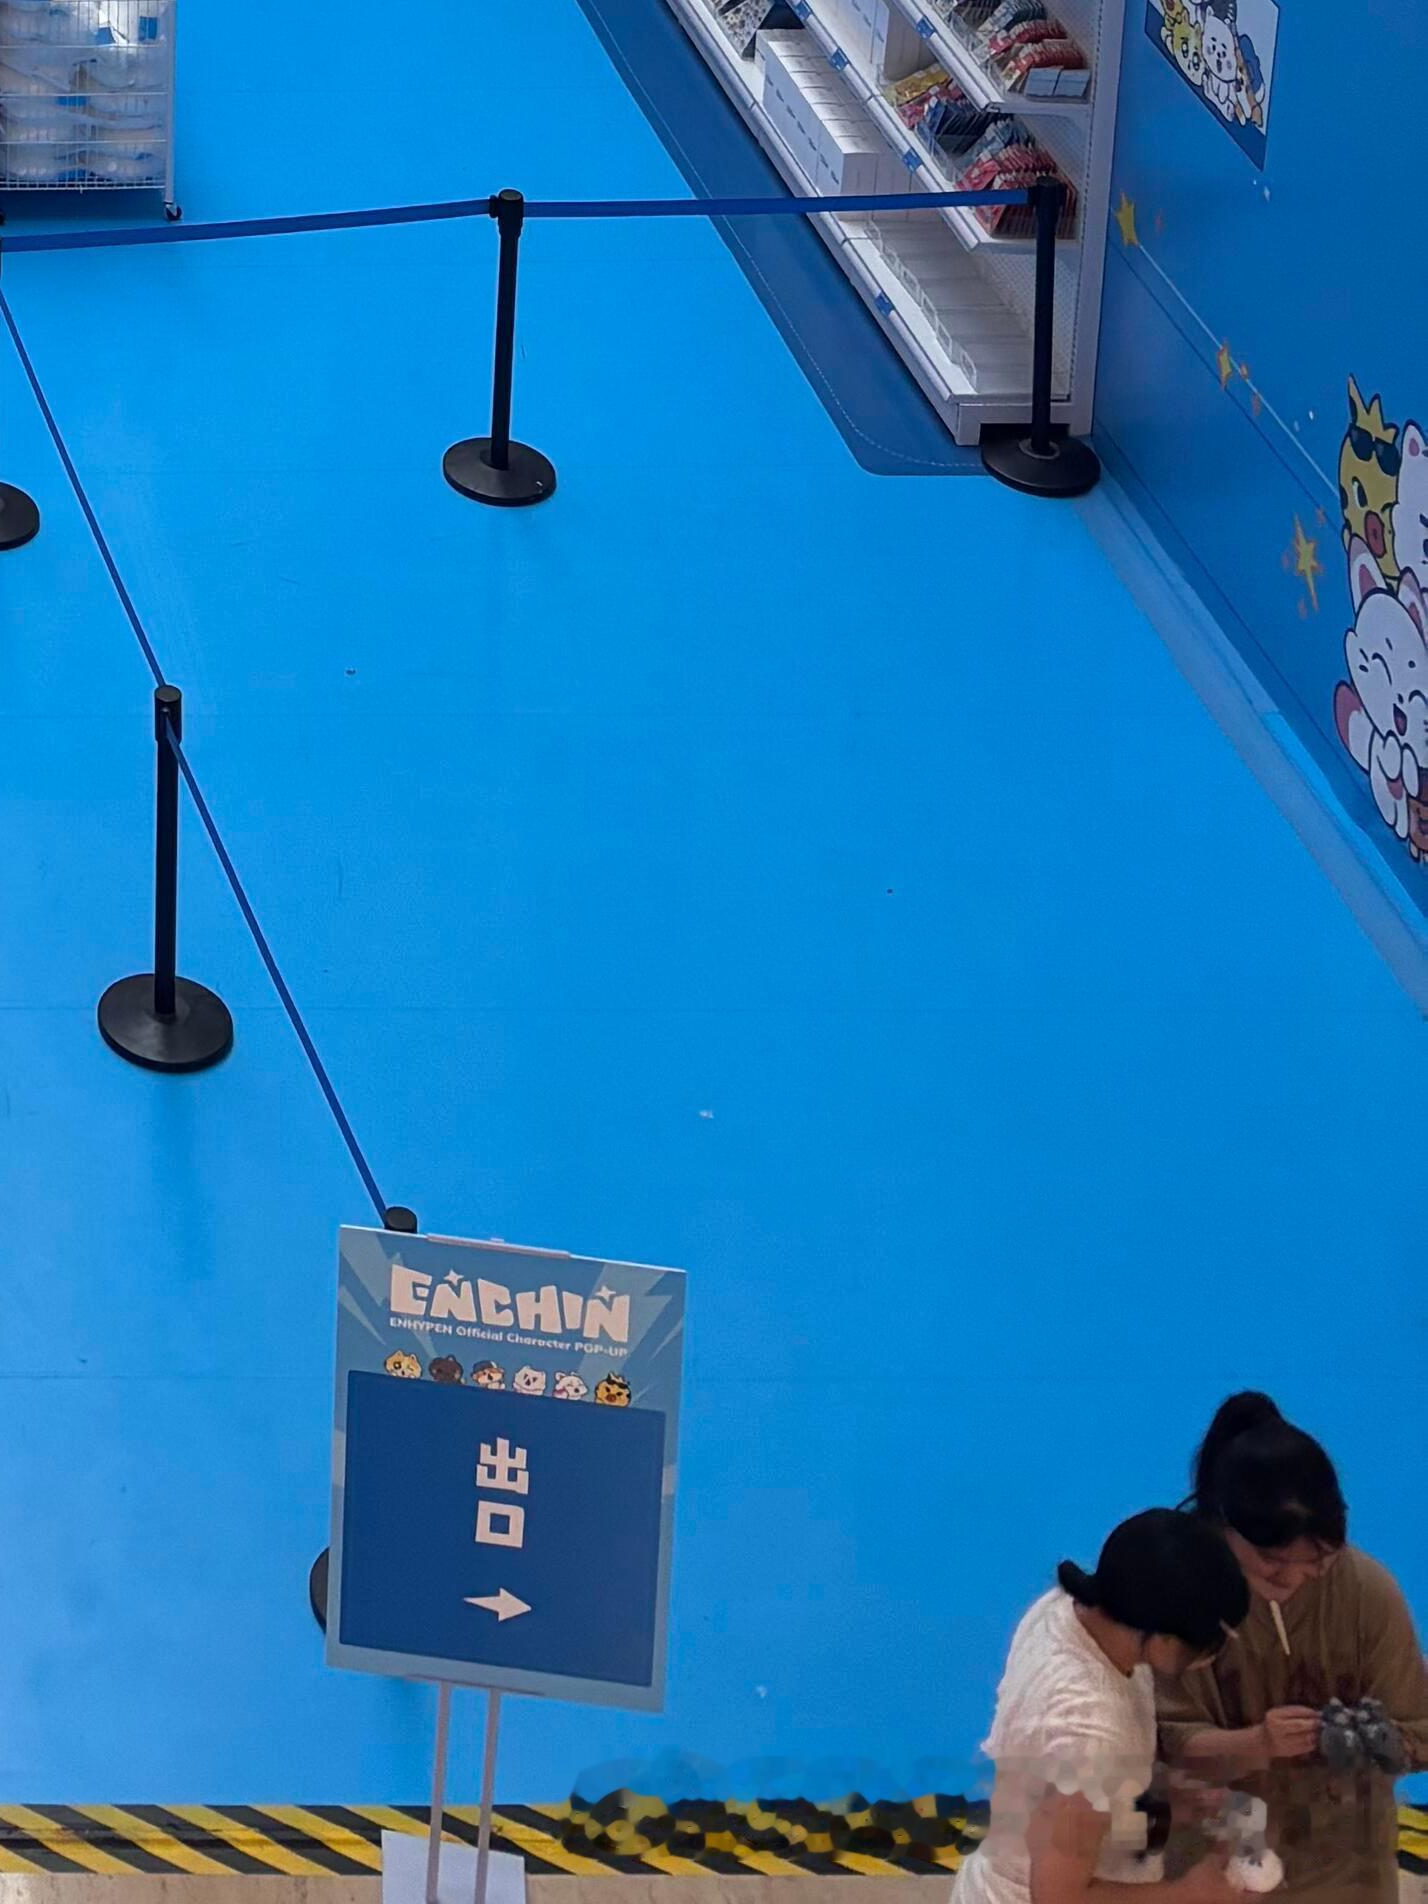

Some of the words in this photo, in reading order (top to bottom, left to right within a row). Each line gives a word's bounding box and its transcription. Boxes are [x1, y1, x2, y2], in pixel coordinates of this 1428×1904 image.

[390, 1264, 630, 1342] ENCHIN
[390, 1317, 452, 1335] ENHYPEN
[456, 1326, 503, 1341] Official
[507, 1332, 571, 1351] Character
[575, 1342, 628, 1357] POP-UP
[475, 1437, 529, 1548] 出口
